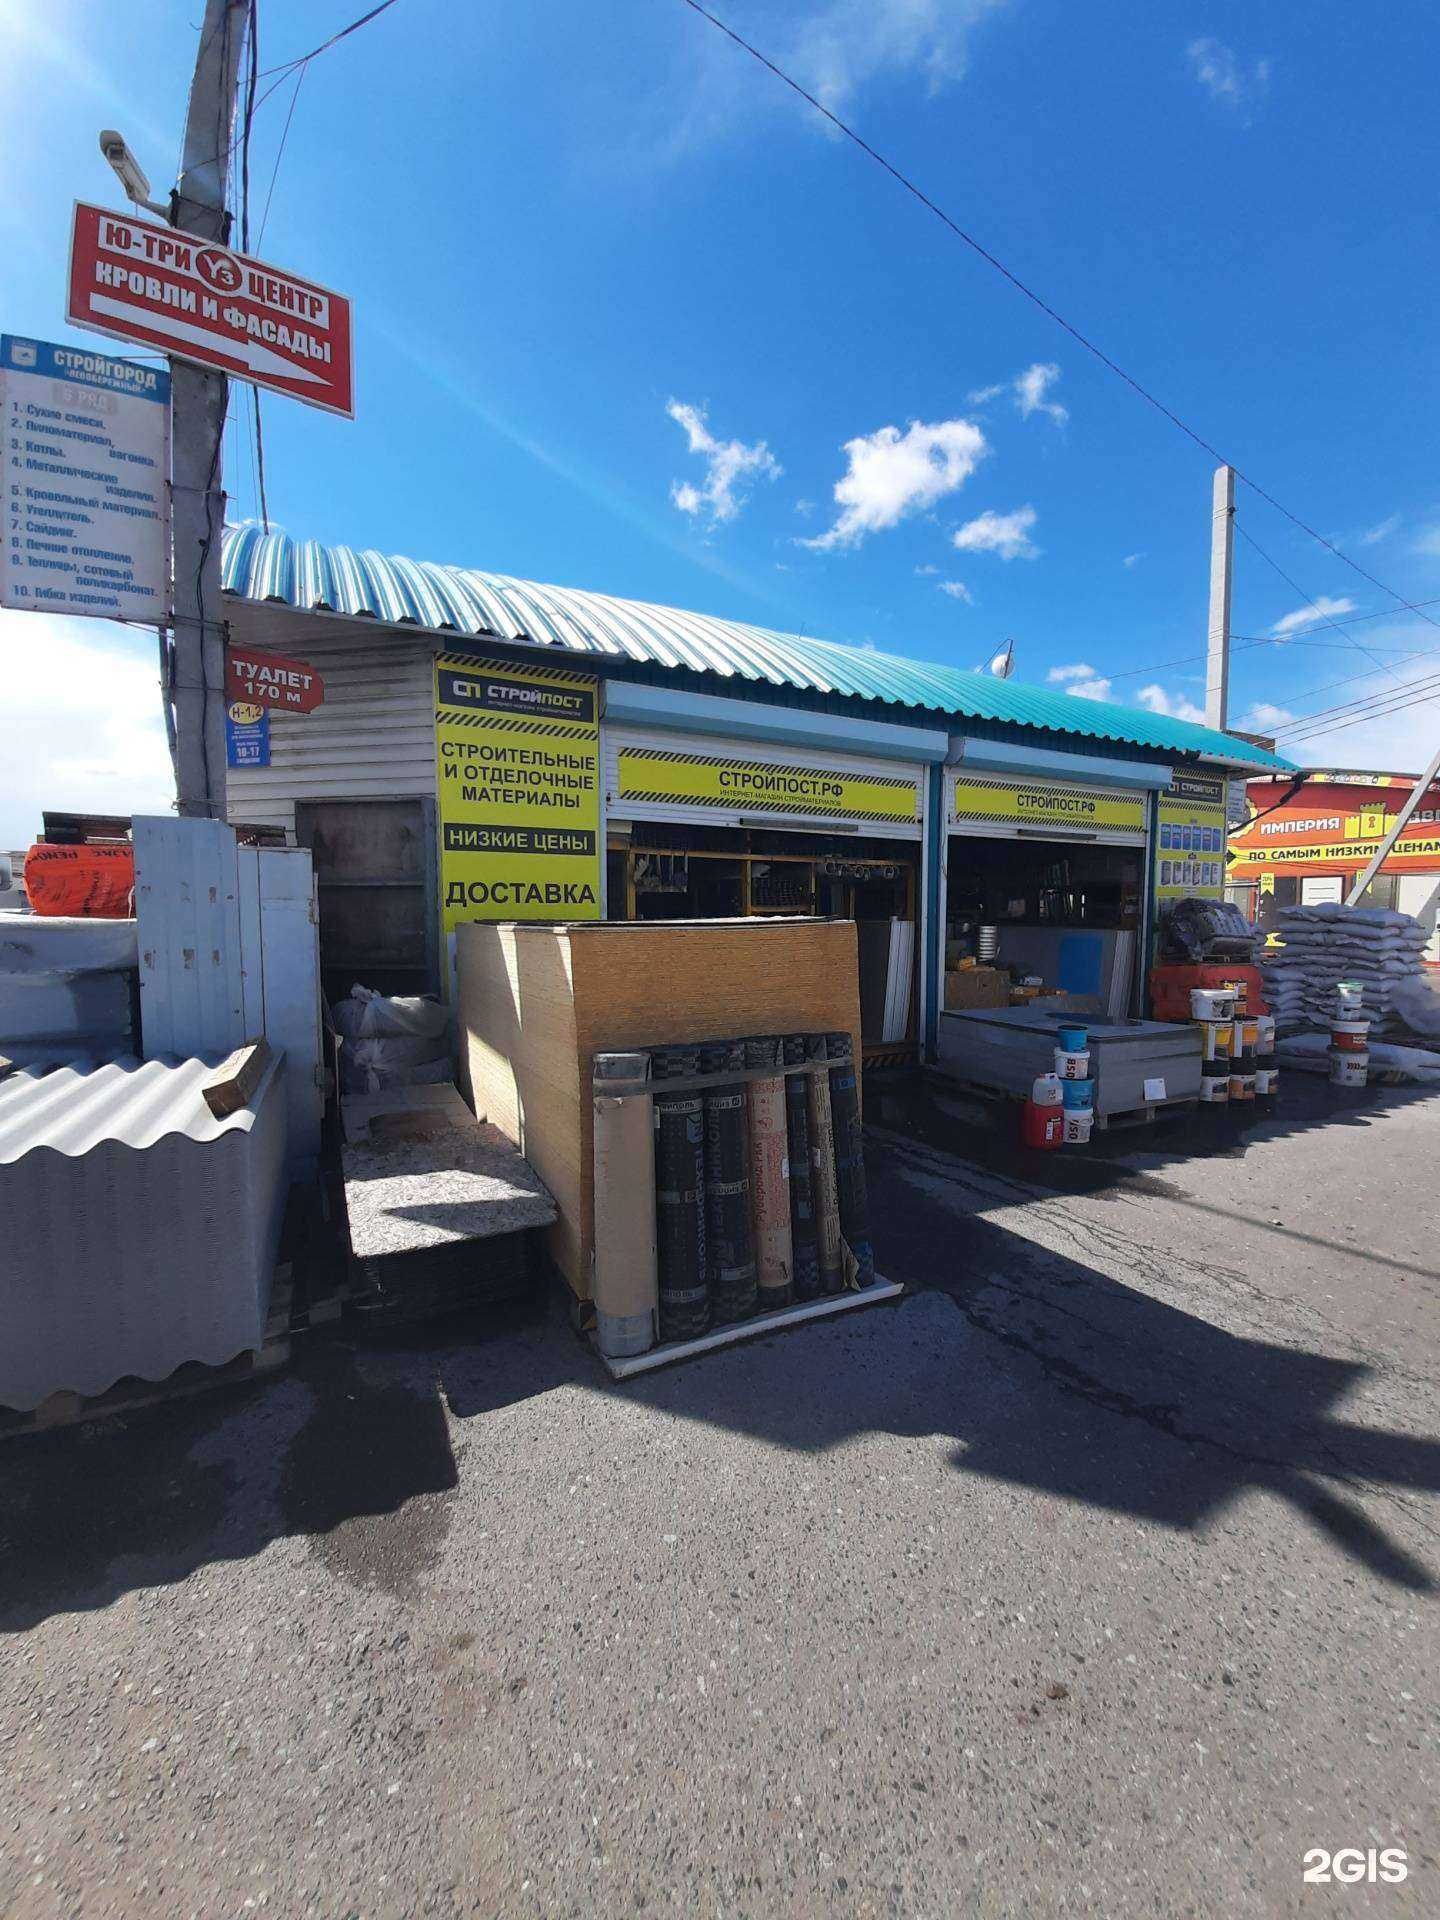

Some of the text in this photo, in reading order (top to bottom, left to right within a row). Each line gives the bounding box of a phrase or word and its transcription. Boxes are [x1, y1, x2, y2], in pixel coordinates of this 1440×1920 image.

[106, 222, 191, 270] Ю-ТРИ
[249, 272, 323, 320] ЦЕНТР
[95, 261, 332, 363] КРОВЛИ И ФАСАДЫ
[54, 350, 157, 390] СТРОЙГОРОД
[26, 404, 62, 421] Сухие
[65, 413, 106, 430] смеси.
[11, 418, 116, 448] 2. Пиломатериал,
[11, 439, 67, 458] 3. Котлы.
[11, 457, 118, 484] 4. Металлические
[26, 487, 99, 509] Кровельный
[102, 501, 163, 521] материал.
[11, 519, 77, 538] 7. Сайдинг.
[83, 565, 134, 581] сотовый
[13, 584, 122, 608] 10. Гибка изделий.
[76, 576, 159, 597] поликарбонат.
[232, 661, 313, 689] ТУАЛЕТ
[244, 682, 280, 699] 170
[487, 684, 583, 709] СТРОЙПОСТ
[441, 741, 595, 771] СТРОИТЕЛЬНЫЕ
[444, 763, 594, 790] И ОТДЕЛОЧНЫЕ
[719, 769, 844, 798] СТРОЙПОСТ.РФ
[1181, 782, 1219, 795] СТРОЙПОСТ
[462, 786, 580, 808] МАТЕРИАЛЫ
[1017, 793, 1096, 813] СТРОЙПОСТ.РФ
[1260, 817, 1340, 836] ИМПЕРИЯ
[450, 829, 588, 851] НИЗКИЕ ЦЕНЫ
[1249, 851, 1266, 861] ПО
[1271, 845, 1321, 860] САМЫМ
[445, 881, 596, 908] ДОСТАВКА
[1066, 1058, 1077, 1079] OSB
